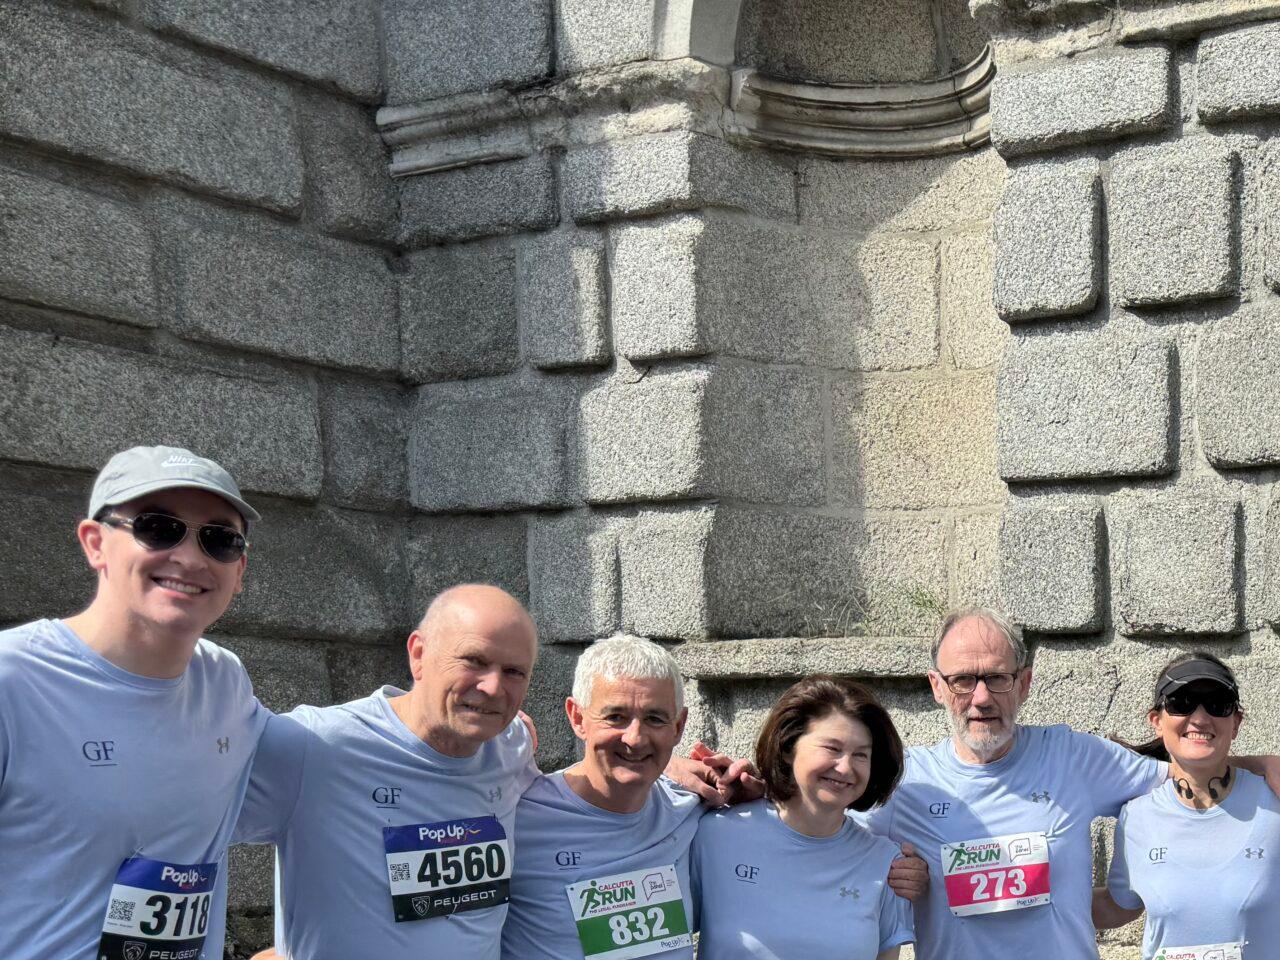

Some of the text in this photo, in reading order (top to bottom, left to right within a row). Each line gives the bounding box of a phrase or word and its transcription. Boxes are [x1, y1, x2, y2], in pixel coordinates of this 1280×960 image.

[82, 741, 115, 762] GF
[372, 787, 402, 804] GF
[929, 803, 950, 815] GF
[418, 826, 445, 842] Pop
[446, 824, 465, 840] Up
[966, 843, 1000, 852] CALCUTTA
[1149, 847, 1167, 862] GF
[555, 851, 582, 867] GF
[966, 849, 1001, 864] RUN
[417, 843, 506, 888] 4560
[735, 863, 760, 880] GF
[599, 880, 634, 891] CALCUTTA
[970, 869, 1027, 900] 273
[434, 889, 497, 908] PEUGEOT
[601, 886, 636, 905] RUN
[140, 894, 210, 936] 3118
[609, 907, 670, 945] 832
[149, 948, 199, 960] PEUGEOT
